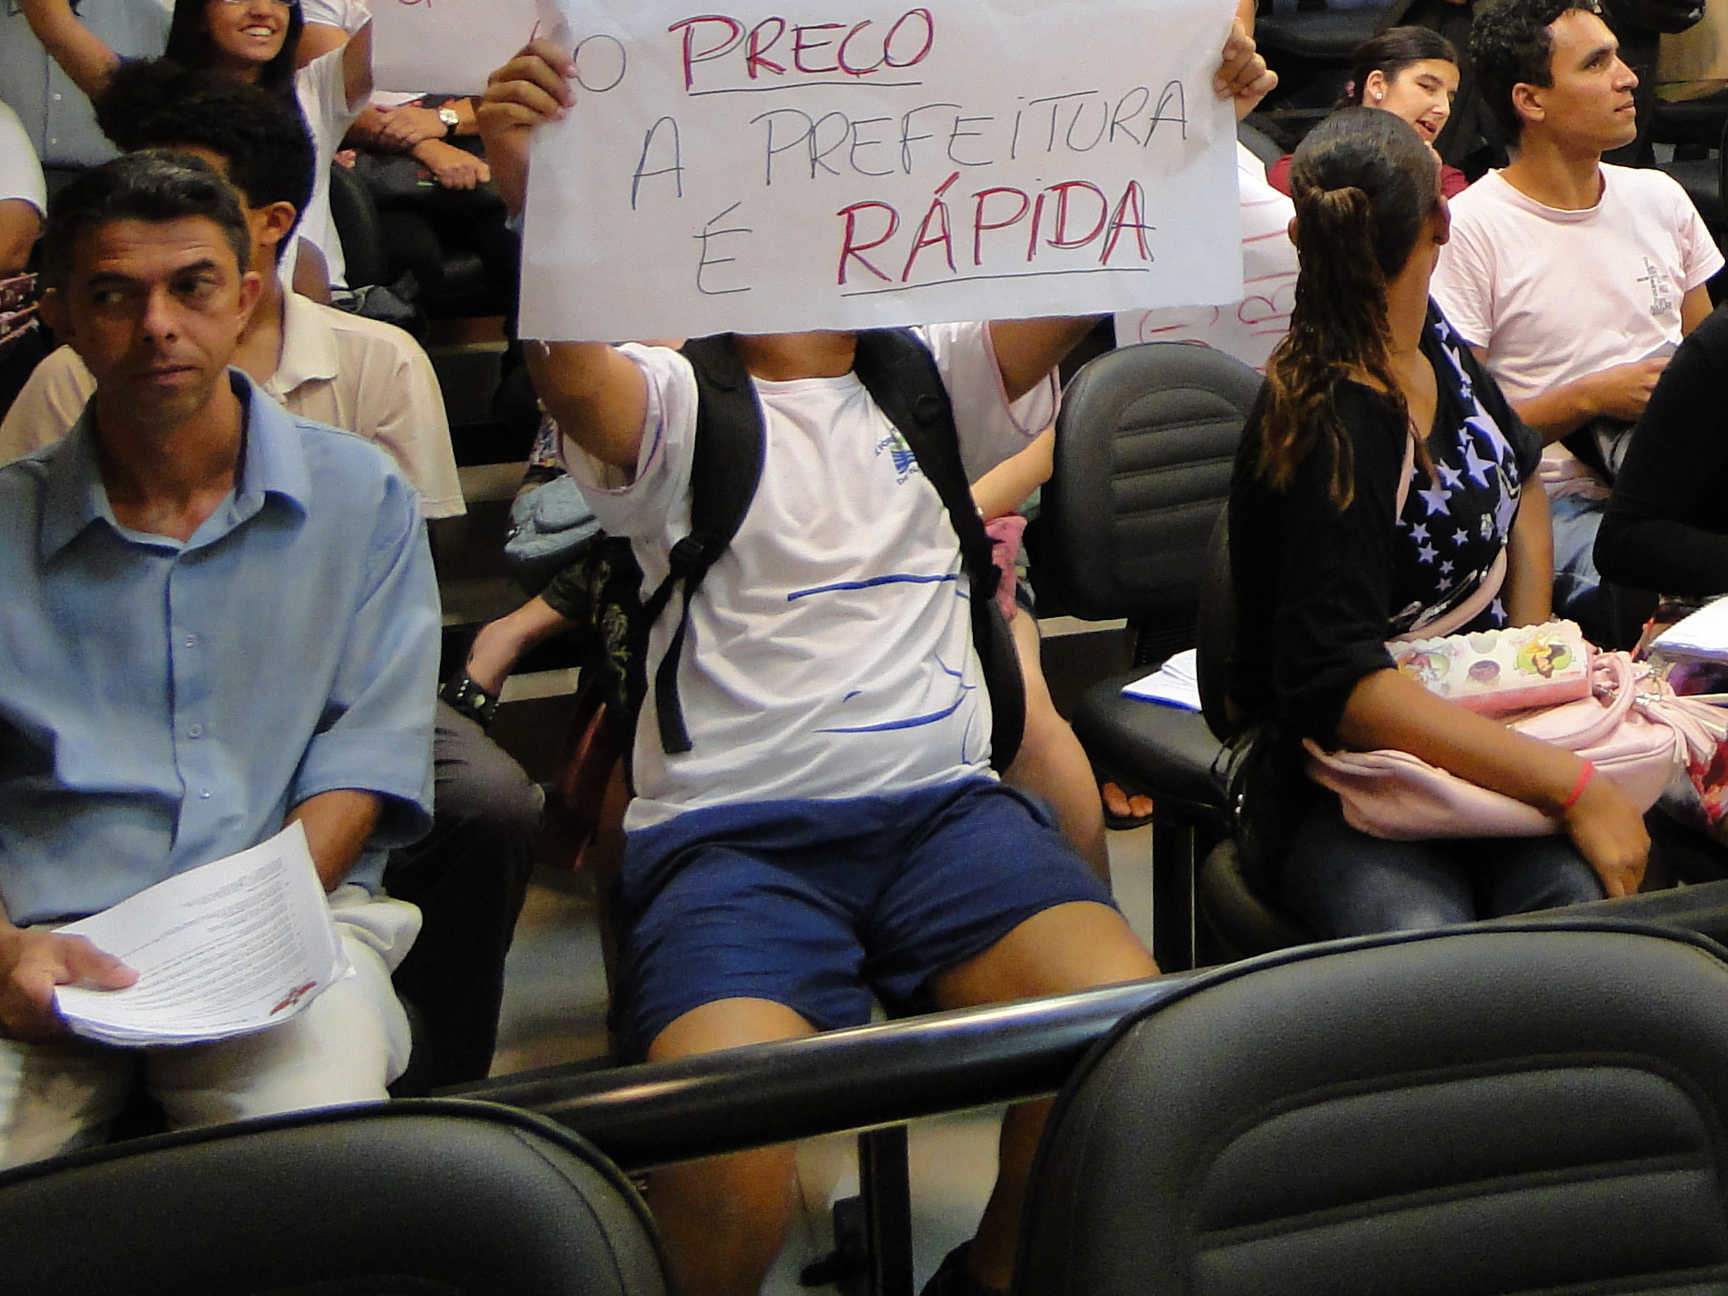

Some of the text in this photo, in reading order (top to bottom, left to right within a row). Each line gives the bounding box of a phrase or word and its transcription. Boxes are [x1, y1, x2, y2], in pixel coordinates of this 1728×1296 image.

[572, 33, 627, 93] O
[630, 115, 684, 211] A
[692, 201, 754, 296] É
[835, 170, 1157, 286] RÁPIDA
